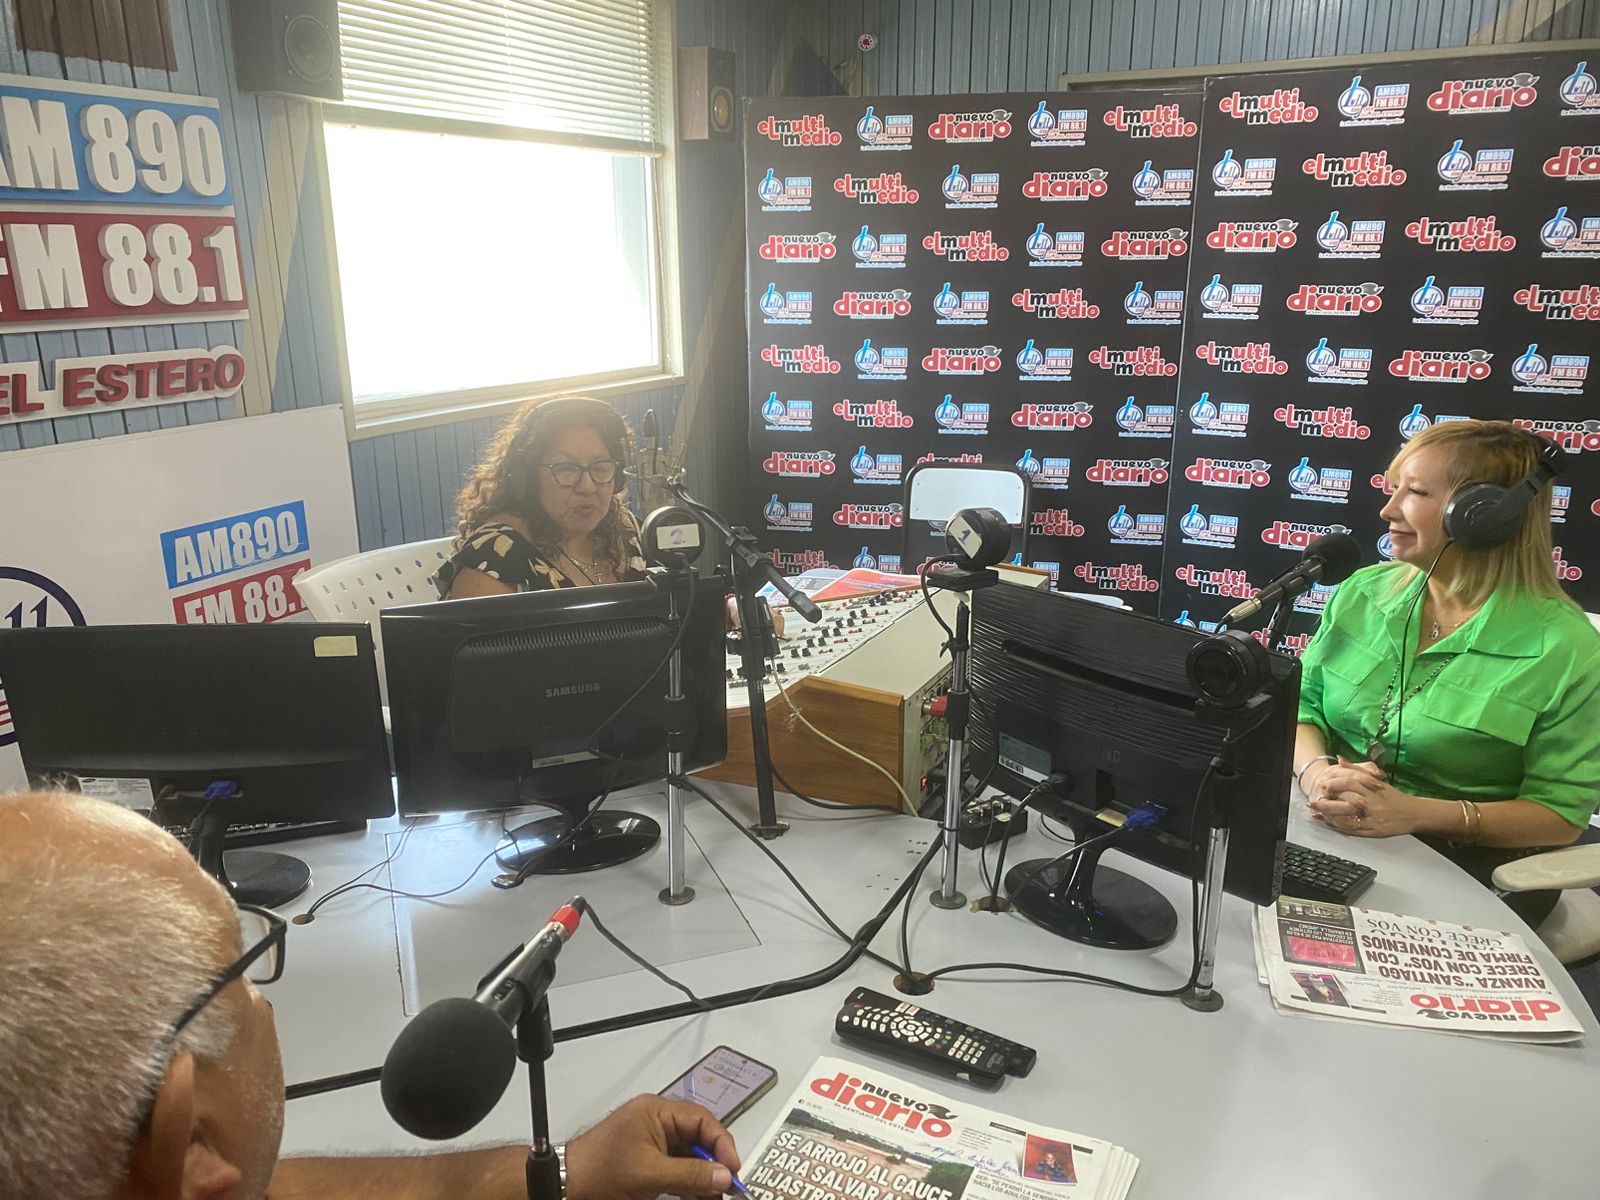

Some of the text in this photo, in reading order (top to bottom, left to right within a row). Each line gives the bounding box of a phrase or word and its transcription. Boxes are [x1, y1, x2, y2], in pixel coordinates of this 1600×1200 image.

[1465, 77, 1515, 90] nuevo
[1428, 79, 1536, 112] diario
[956, 112, 994, 122] nuevo
[1247, 101, 1317, 124] medio
[781, 126, 841, 145] medio
[929, 114, 1009, 140] diario
[1129, 117, 1196, 137] medio
[0, 96, 227, 197] M 890
[1543, 147, 1600, 176] dia
[1051, 171, 1090, 181] nuevo
[1331, 164, 1406, 186] medio
[858, 184, 918, 203] medio
[1023, 173, 1106, 198] diario
[1130, 230, 1169, 239] nuevo
[1237, 222, 1279, 231] nuevo
[785, 235, 819, 244] nuevo
[1102, 232, 1185, 257] diario
[1207, 224, 1296, 249] diario
[1436, 230, 1515, 251] medio
[760, 237, 834, 260] diario
[946, 242, 1008, 260] medio
[100, 222, 244, 307] 88.1
[859, 292, 894, 300] nuevo
[1319, 285, 1362, 295] nuevo
[834, 294, 909, 316] diario
[1287, 286, 1381, 313] diario
[1037, 300, 1099, 318] medio
[923, 350, 999, 372] diario
[949, 348, 984, 356] nuevo
[1424, 351, 1471, 362] nuevo
[783, 357, 840, 374] medio
[1114, 358, 1176, 375] medio
[1222, 355, 1287, 375] medio
[1389, 351, 1491, 380] diario
[63, 352, 246, 408] ESTERO
[1012, 406, 1090, 428] diario
[1038, 404, 1075, 413] nuevo
[855, 411, 912, 428] medio
[1534, 421, 1585, 432] nuevo
[1301, 419, 1370, 440] medio
[764, 454, 834, 475] diario
[787, 452, 820, 460] nuevo
[1114, 457, 1151, 466] nuevo
[1214, 459, 1252, 470] nuevo
[1087, 459, 1166, 482] diario
[1186, 458, 1268, 486] diario
[859, 505, 894, 513] nuevo
[670, 528, 687, 545] 2
[957, 528, 971, 546] 1
[1290, 523, 1332, 534] nuevo
[174, 510, 300, 584] AM890
[1098, 575, 1159, 593] medio
[545, 682, 601, 698] SAMSUNG
[1367, 918, 1403, 932] VOS
[1406, 924, 1442, 939] CON
[1361, 934, 1453, 960] CONVENIOS
[1448, 931, 1503, 946] CRECE
[1366, 950, 1400, 966] CON
[1457, 951, 1478, 963] DE
[1481, 952, 1534, 965] FIRMA
[1448, 961, 1482, 975] CON
[1483, 965, 1541, 976] CRECE
[1476, 976, 1547, 989] AVANZA
[1409, 993, 1562, 1022] diario
[1447, 1010, 1517, 1022] nuevo
[809, 1071, 953, 1139] diario
[860, 1082, 929, 1112] nuevo
[763, 1148, 807, 1178] PARA
[810, 1165, 880, 1200] SALVAR
[776, 1131, 802, 1148] SE
[798, 1139, 869, 1176] ARROJÓ
[867, 1164, 889, 1187] AL
[892, 1173, 953, 1200] CAUCE
